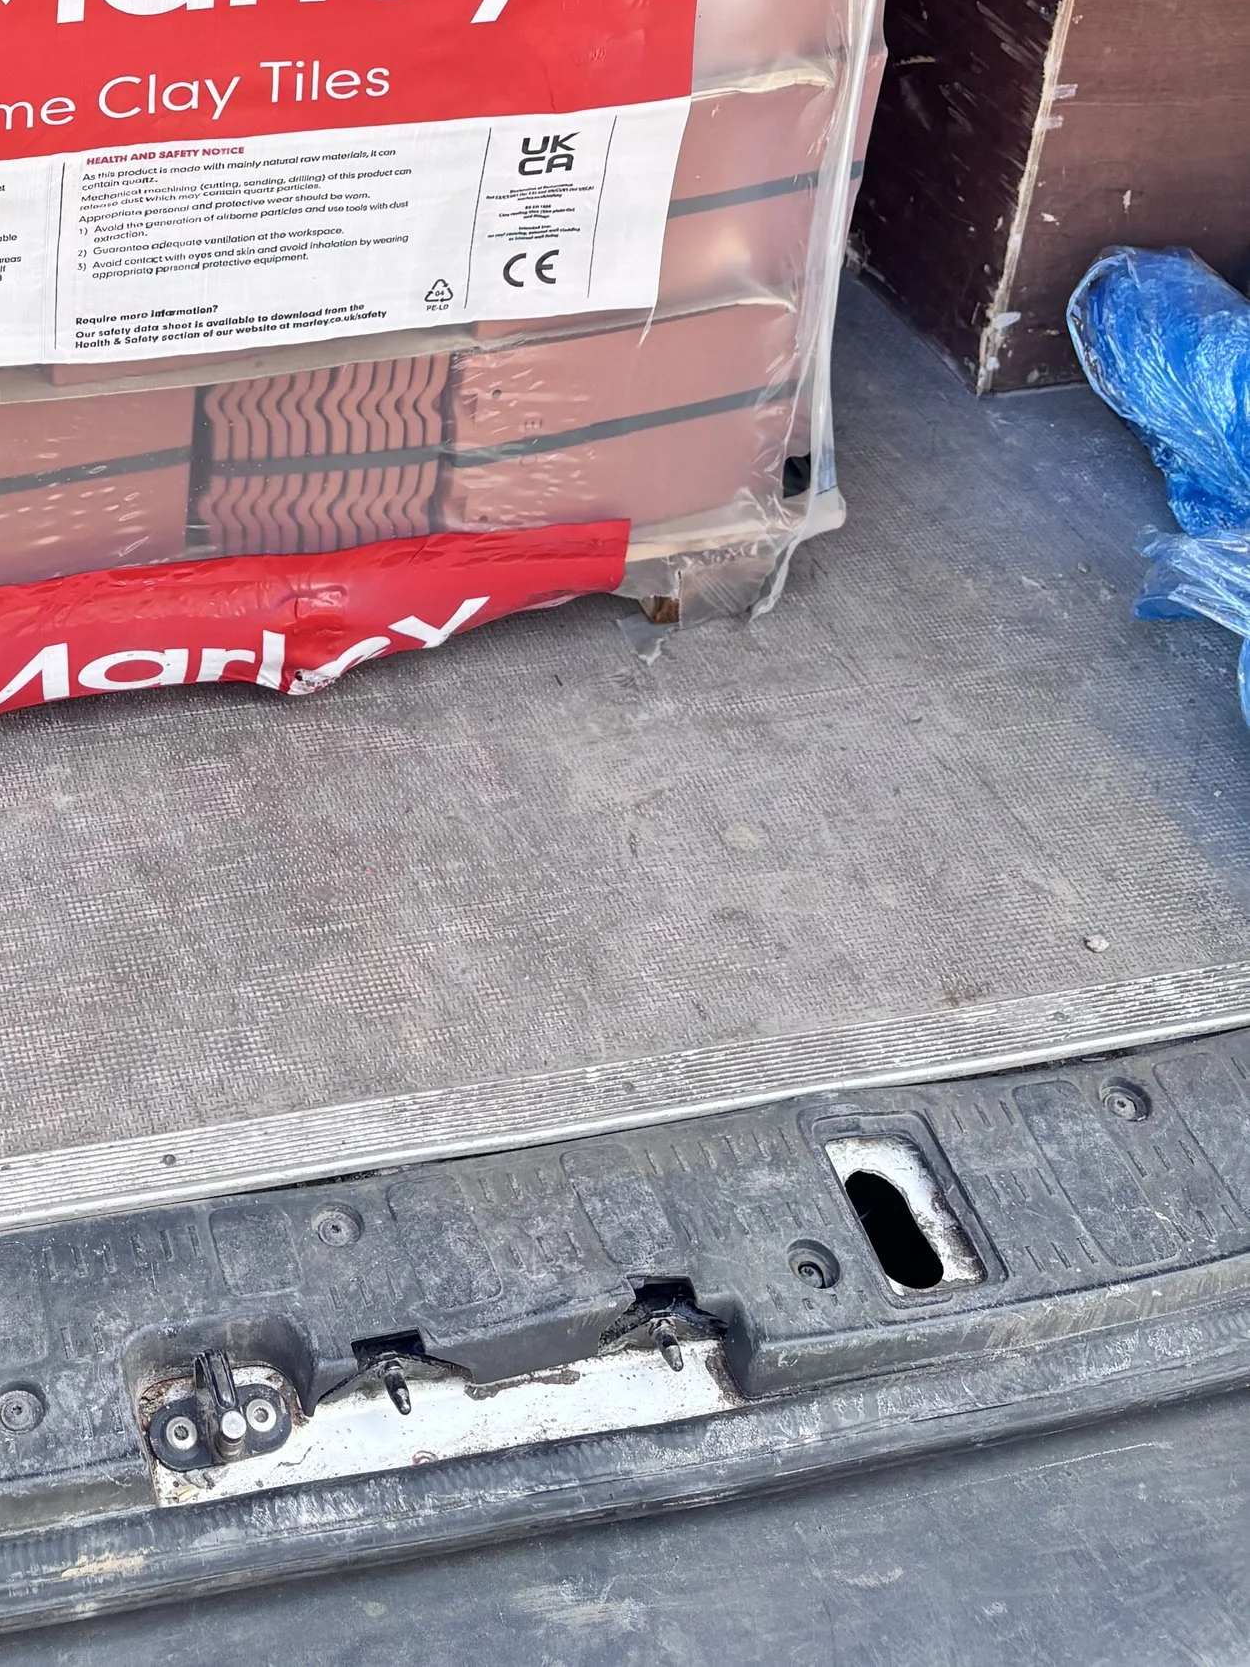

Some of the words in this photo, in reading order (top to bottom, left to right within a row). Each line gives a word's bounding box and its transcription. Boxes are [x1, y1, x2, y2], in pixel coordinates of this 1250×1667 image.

[97, 74, 242, 120] Clay
[259, 60, 390, 103] Tiles
[522, 132, 580, 156] UK
[86, 156, 127, 165] HEALTH
[130, 154, 156, 162] AND
[158, 151, 198, 160] SAFETY
[201, 148, 244, 157] NOTICE
[519, 153, 575, 176] CA
[117, 167, 158, 180] product
[170, 165, 200, 173] made
[203, 163, 225, 171] with
[226, 160, 261, 169] mainly
[262, 157, 298, 166] natural
[81, 181, 120, 191] contain
[120, 177, 158, 188] quartz.
[92, 259, 122, 268] Avoid
[164, 253, 186, 261] with
[188, 253, 212, 261] eyes
[213, 249, 235, 257] and
[236, 247, 256, 255] skin
[256, 245, 278, 253] and
[279, 243, 308, 251] avoid
[309, 240, 358, 249] inhalation
[359, 238, 372, 247] by
[372, 235, 409, 244] wearing
[150, 239, 202, 249] adequate
[204, 234, 256, 244] ventilation
[257, 232, 268, 240] at
[503, 249, 560, 288] CE
[75, 315, 117, 325] Require
[98, 327, 131, 336] safety
[133, 325, 159, 333] data
[162, 321, 192, 330] sheet
[206, 317, 255, 327] available
[270, 309, 323, 321] download
[349, 304, 364, 312] the
[74, 339, 110, 348] Health
[124, 335, 159, 344] Safety
[161, 332, 200, 341] section
[235, 324, 277, 334] website
[279, 321, 290, 329] at
